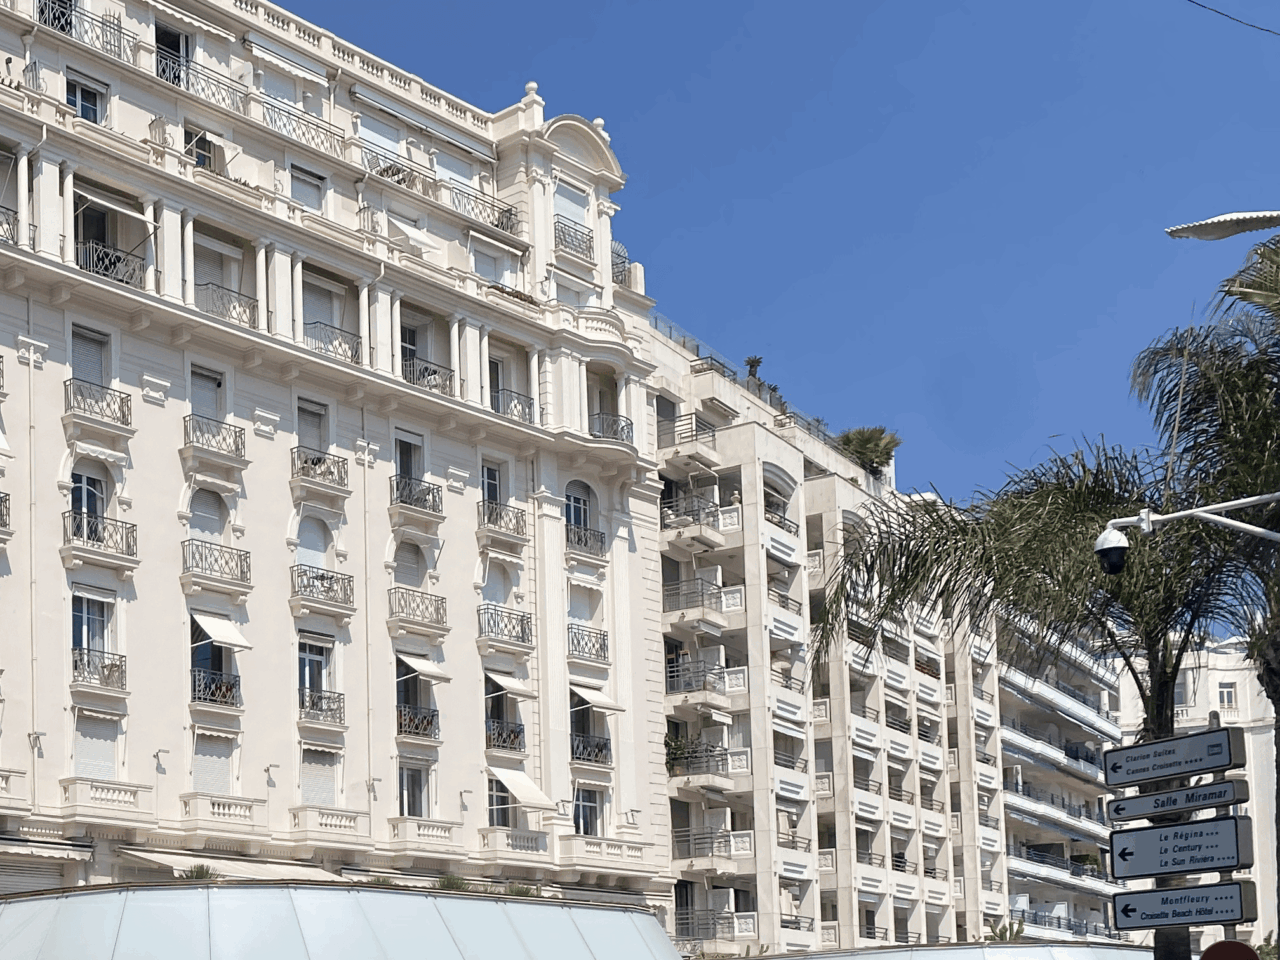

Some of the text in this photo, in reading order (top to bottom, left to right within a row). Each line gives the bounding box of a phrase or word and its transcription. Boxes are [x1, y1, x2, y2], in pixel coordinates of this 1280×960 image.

[1125, 748, 1176, 763] Clarion Suites
[1126, 760, 1182, 775] Cannes Croisette
[1153, 789, 1227, 809] Salle Miramar
[1159, 833, 1169, 841] Le
[1159, 844, 1203, 855] Le Century
[1159, 859, 1169, 867] Le
[1171, 857, 1186, 866] Sun
[1161, 895, 1210, 905] Montfleury
[1140, 911, 1169, 920] Croisette
[1171, 908, 1193, 918] Beach
